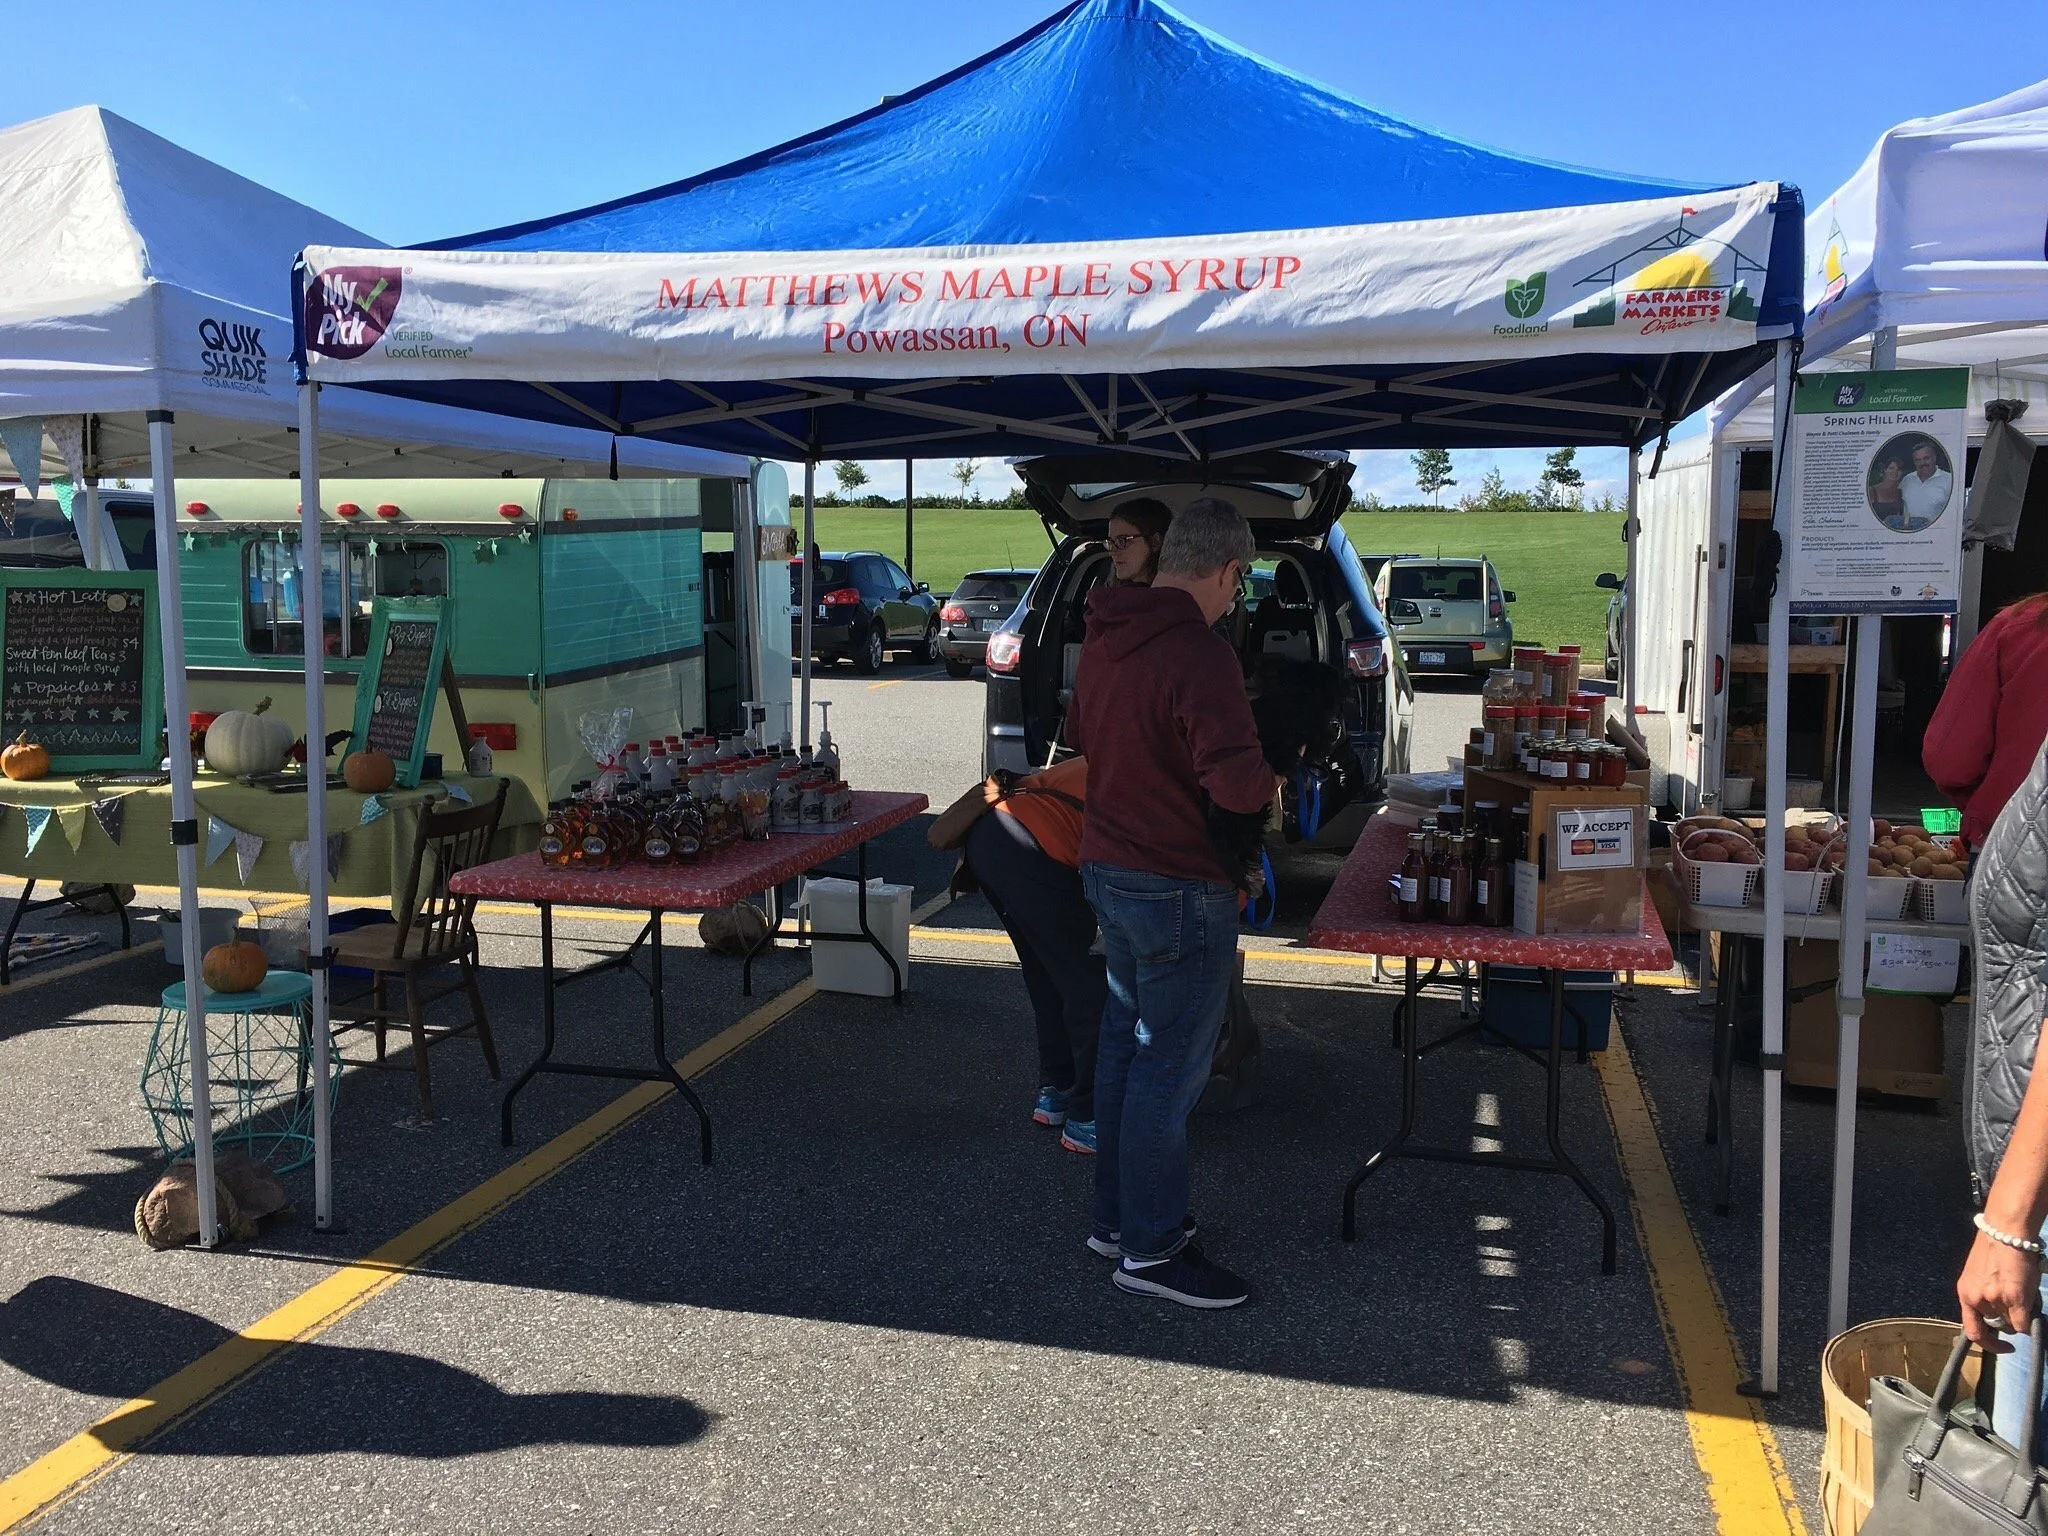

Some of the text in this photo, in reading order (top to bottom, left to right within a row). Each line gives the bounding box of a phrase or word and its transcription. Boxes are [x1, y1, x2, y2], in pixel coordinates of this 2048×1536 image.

[656, 255, 1301, 310] MATTHEWS MAPLE SYRUP
[322, 273, 358, 315] My
[1621, 303, 1721, 320] MARKETS
[316, 308, 368, 346] Pick
[821, 313, 1092, 354] Powassan, ON
[1492, 321, 1549, 335] Foodland
[1640, 317, 1707, 336] Ontario
[198, 318, 267, 358] QUIK
[391, 330, 434, 342] VERIFIED
[384, 345, 420, 359] Local
[200, 350, 267, 385] SHADE
[1839, 385, 1854, 397] My
[1869, 394, 1892, 404] Local
[1837, 393, 1855, 406] Pick
[1824, 413, 1935, 427] SPRING HILL FARMS
[38, 590, 67, 605] Hot
[6, 646, 39, 660] Sweet
[64, 645, 88, 662] Iced
[7, 662, 29, 674] with
[33, 662, 56, 675] local
[61, 662, 91, 674] maple
[25, 680, 101, 697] Popsicles
[1561, 821, 1631, 834] WE ACCEPT
